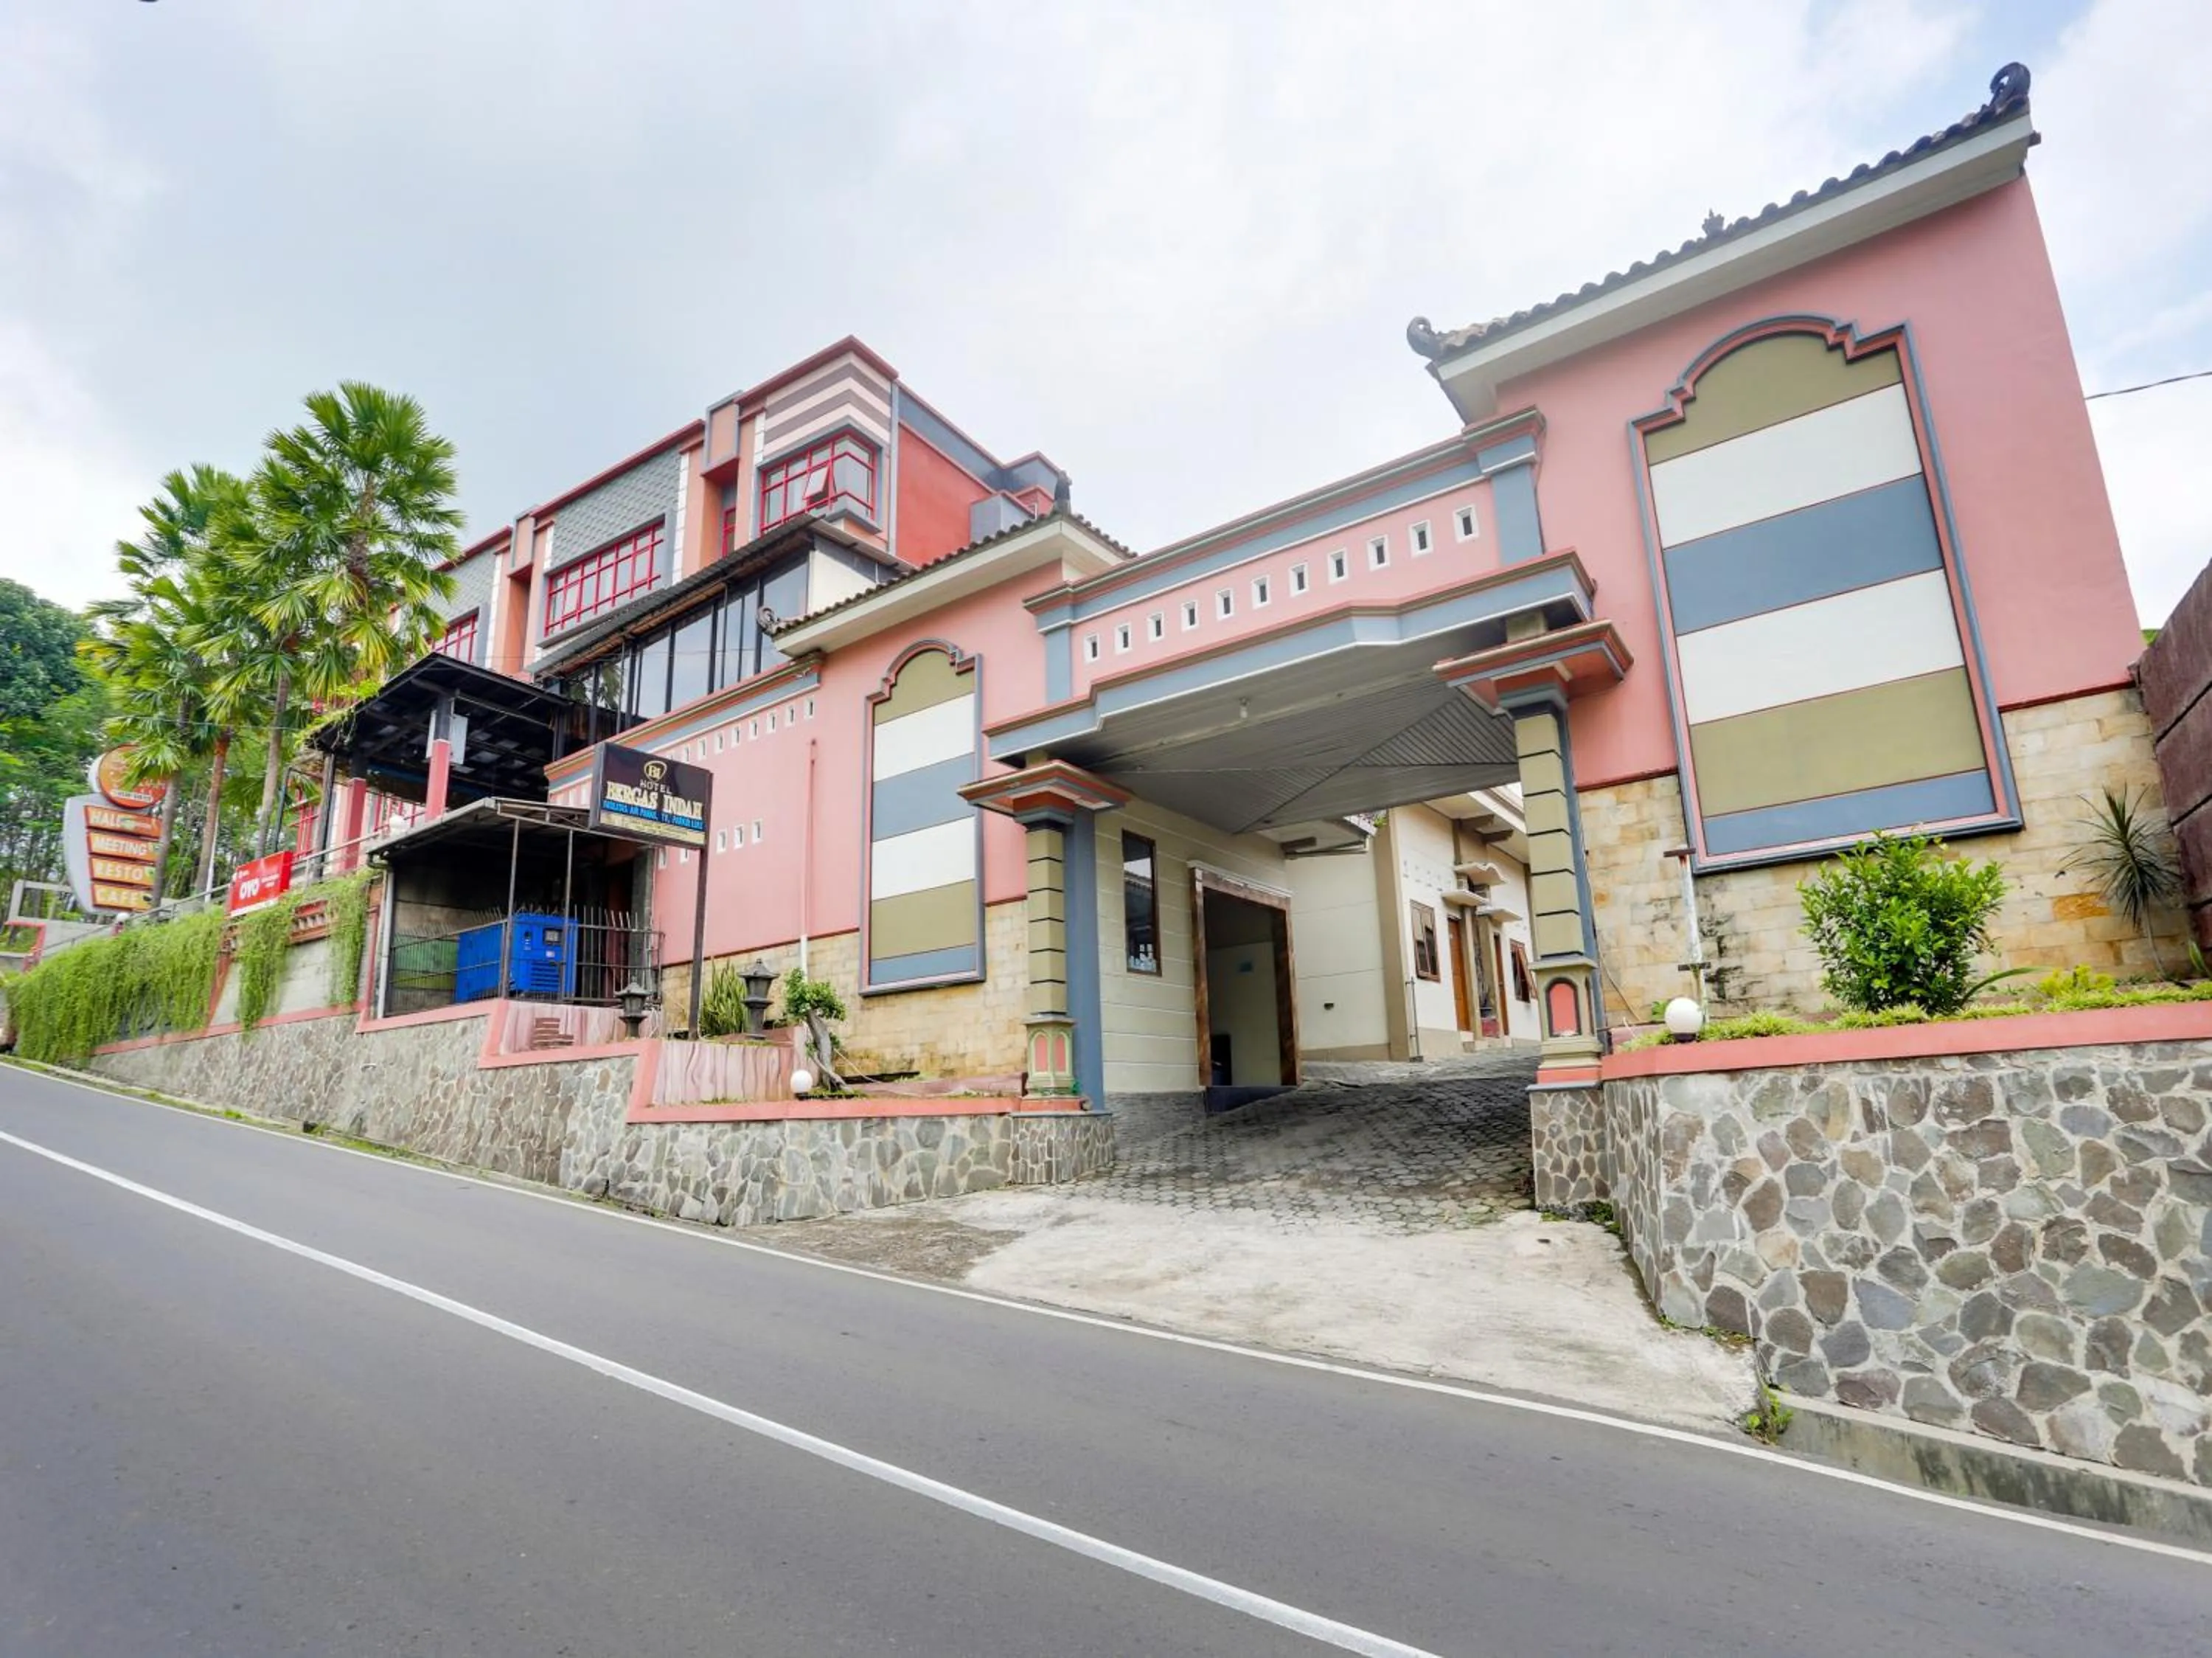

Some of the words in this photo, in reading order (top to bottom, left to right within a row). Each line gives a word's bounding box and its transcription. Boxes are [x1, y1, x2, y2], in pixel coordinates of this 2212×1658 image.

[640, 780, 673, 794] HOTEL
[606, 781, 658, 808] BERGAS
[663, 794, 703, 819] INDAH
[95, 836, 147, 856] MEETING
[95, 861, 143, 881] RESTO
[97, 887, 139, 906] CAFE
[240, 878, 260, 900] OYO
